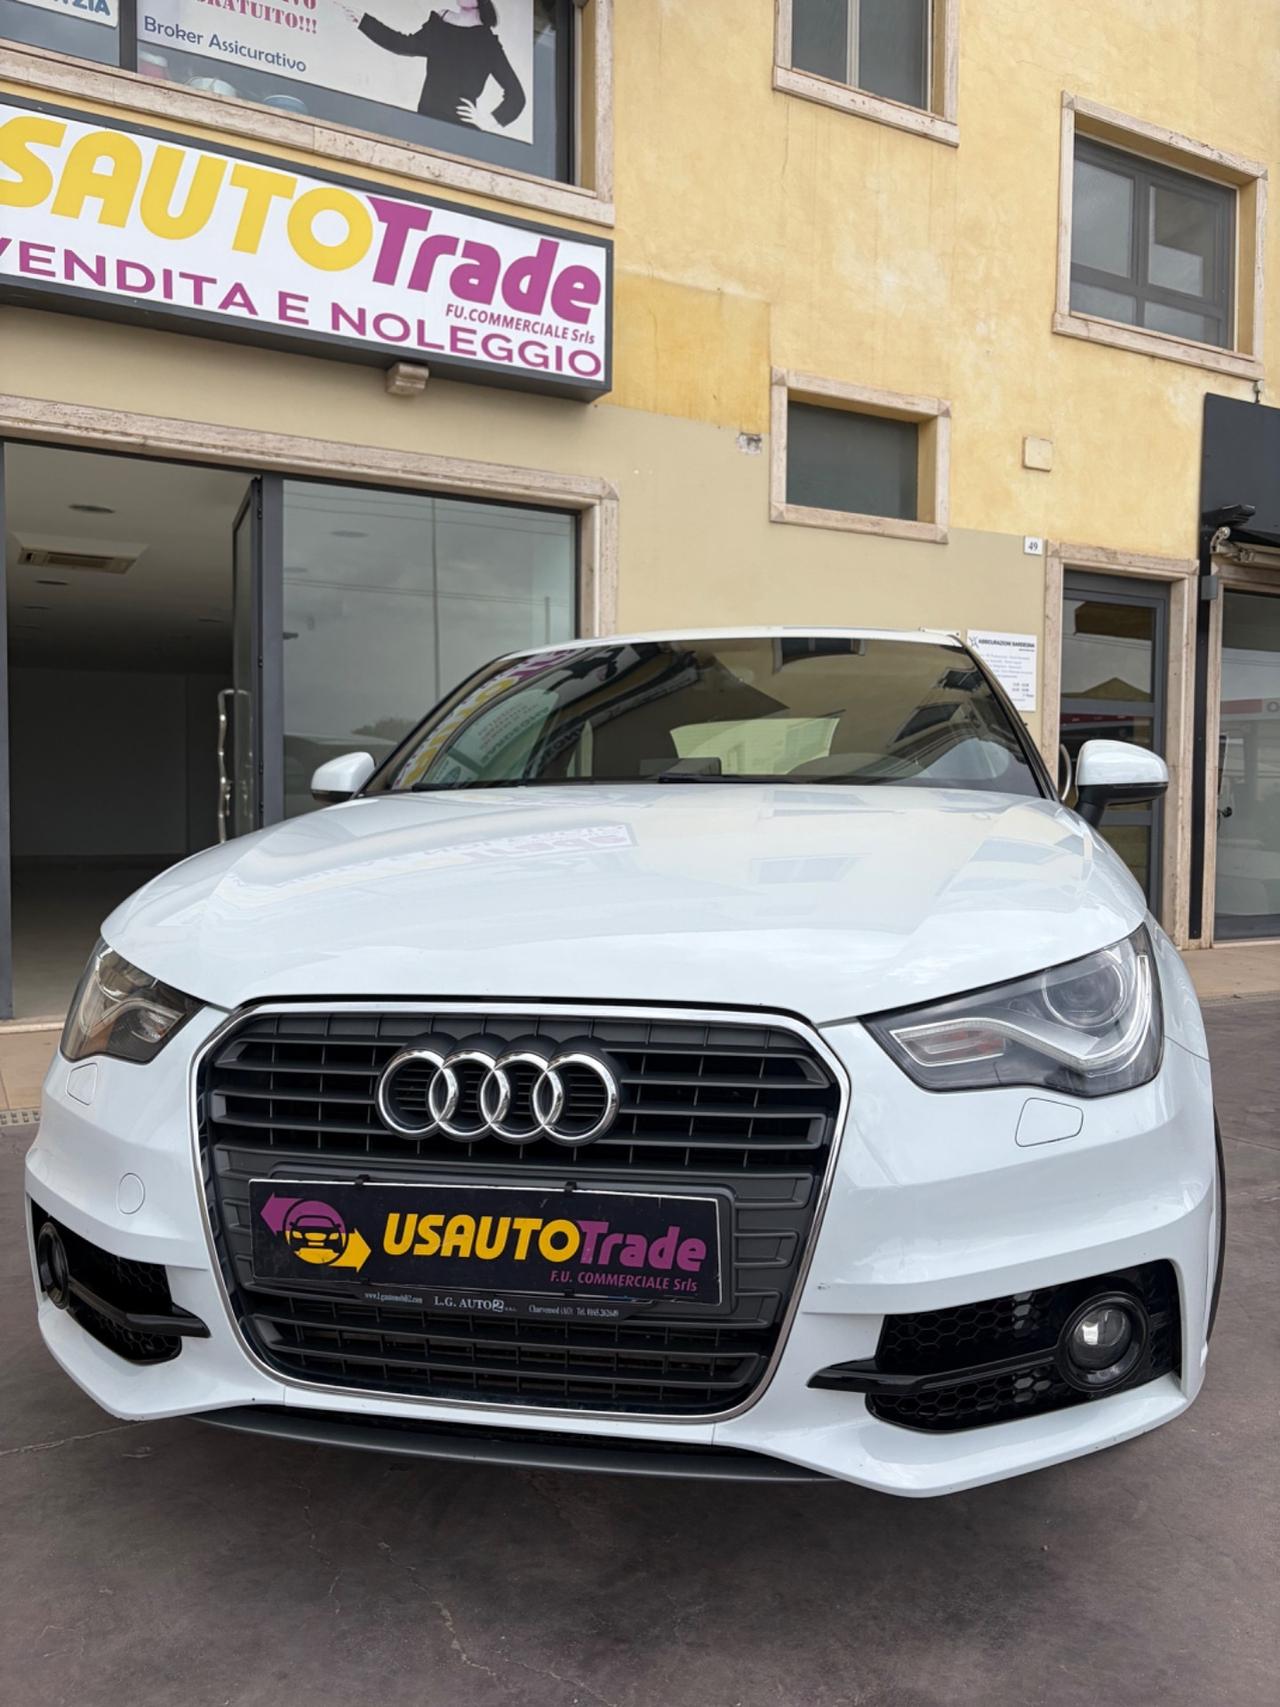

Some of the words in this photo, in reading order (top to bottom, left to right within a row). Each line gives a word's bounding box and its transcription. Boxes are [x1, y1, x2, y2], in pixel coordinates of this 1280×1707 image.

[144, 16, 203, 45] Broker
[208, 34, 306, 72] Assicurativo
[278, 291, 309, 325] E
[331, 302, 601, 377] NOLEGGIO
[446, 304, 569, 340] FU.COMMERCIALE
[571, 329, 595, 344] Srls
[1028, 541, 1038, 551] 49
[383, 1212, 706, 1272] USAUTOTrade
[550, 1270, 572, 1282] F.U.
[577, 1272, 669, 1289] COMMERCIALE
[673, 1278, 698, 1292] Srls
[434, 1296, 456, 1307] L.G.
